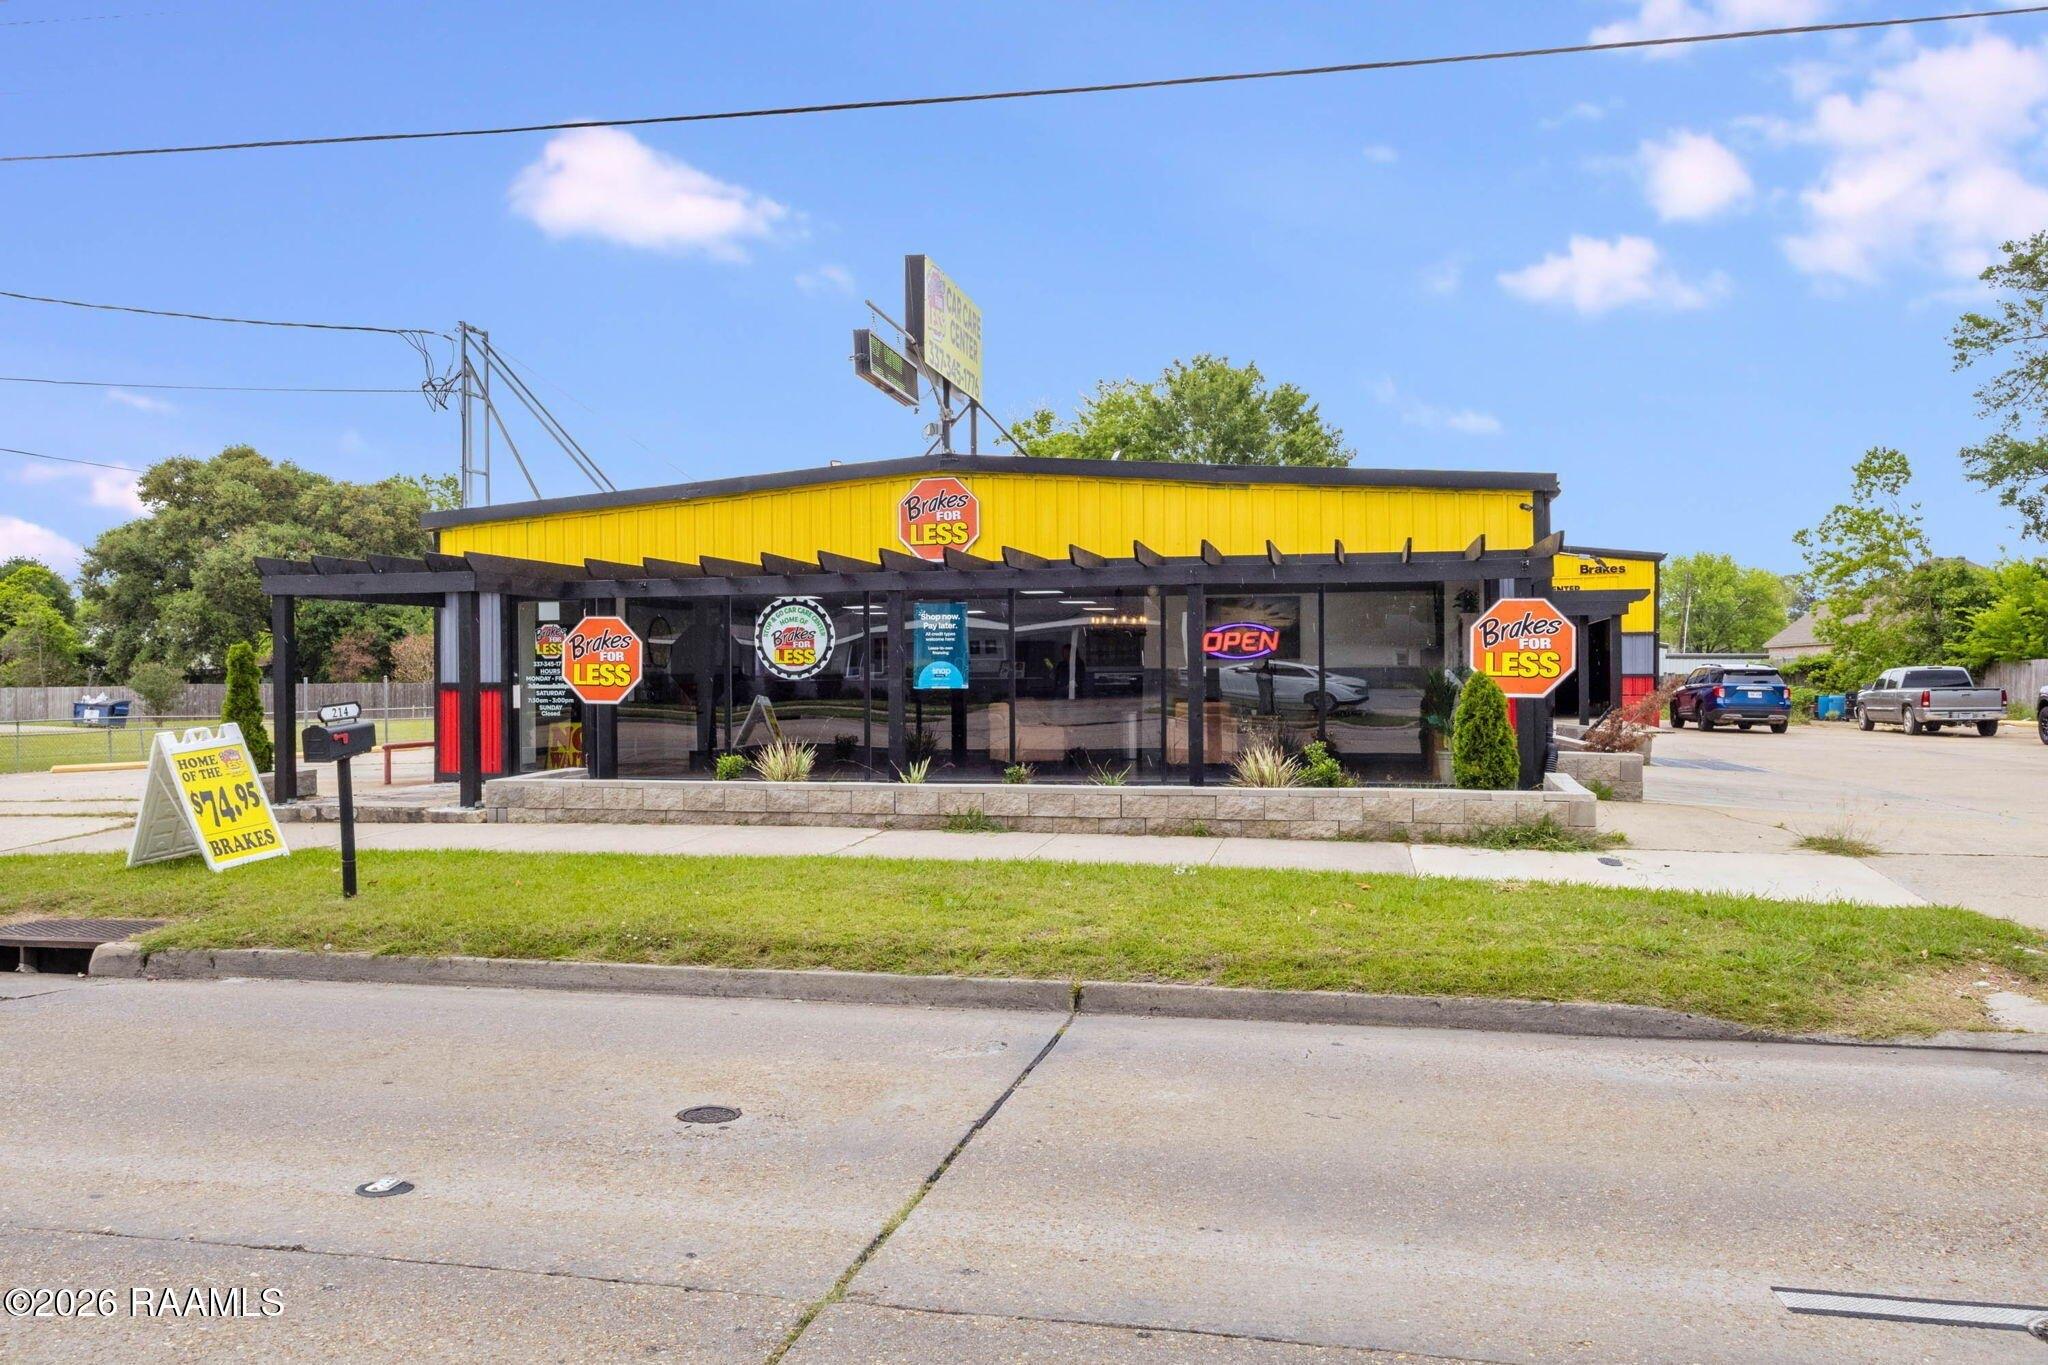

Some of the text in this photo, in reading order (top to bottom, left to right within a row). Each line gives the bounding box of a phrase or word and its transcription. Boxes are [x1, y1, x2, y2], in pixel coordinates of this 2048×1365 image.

[946, 288, 962, 322] CAR
[962, 303, 981, 341] CARE
[950, 320, 979, 365] CENTER
[904, 489, 969, 521] Brakes
[936, 510, 961, 521] FOR
[910, 522, 969, 545] LESS
[1580, 564, 1626, 574] Brakes
[779, 616, 799, 625] HOME
[921, 613, 941, 621] Shop
[923, 622, 937, 630] Pay
[771, 626, 816, 648] Brakes
[1479, 612, 1563, 648] Brakes
[569, 629, 633, 660] Brakes
[1202, 631, 1280, 652] OPEN
[1519, 638, 1552, 650] FOR
[600, 651, 625, 662] FOR
[773, 648, 816, 665] LESS
[1485, 651, 1561, 678] LESS
[573, 663, 631, 687] LESS
[332, 706, 348, 718] 214
[176, 754, 219, 771] HOME
[182, 766, 223, 783] OF THE
[190, 781, 261, 828] $74.95
[209, 828, 276, 857] BRAKES
